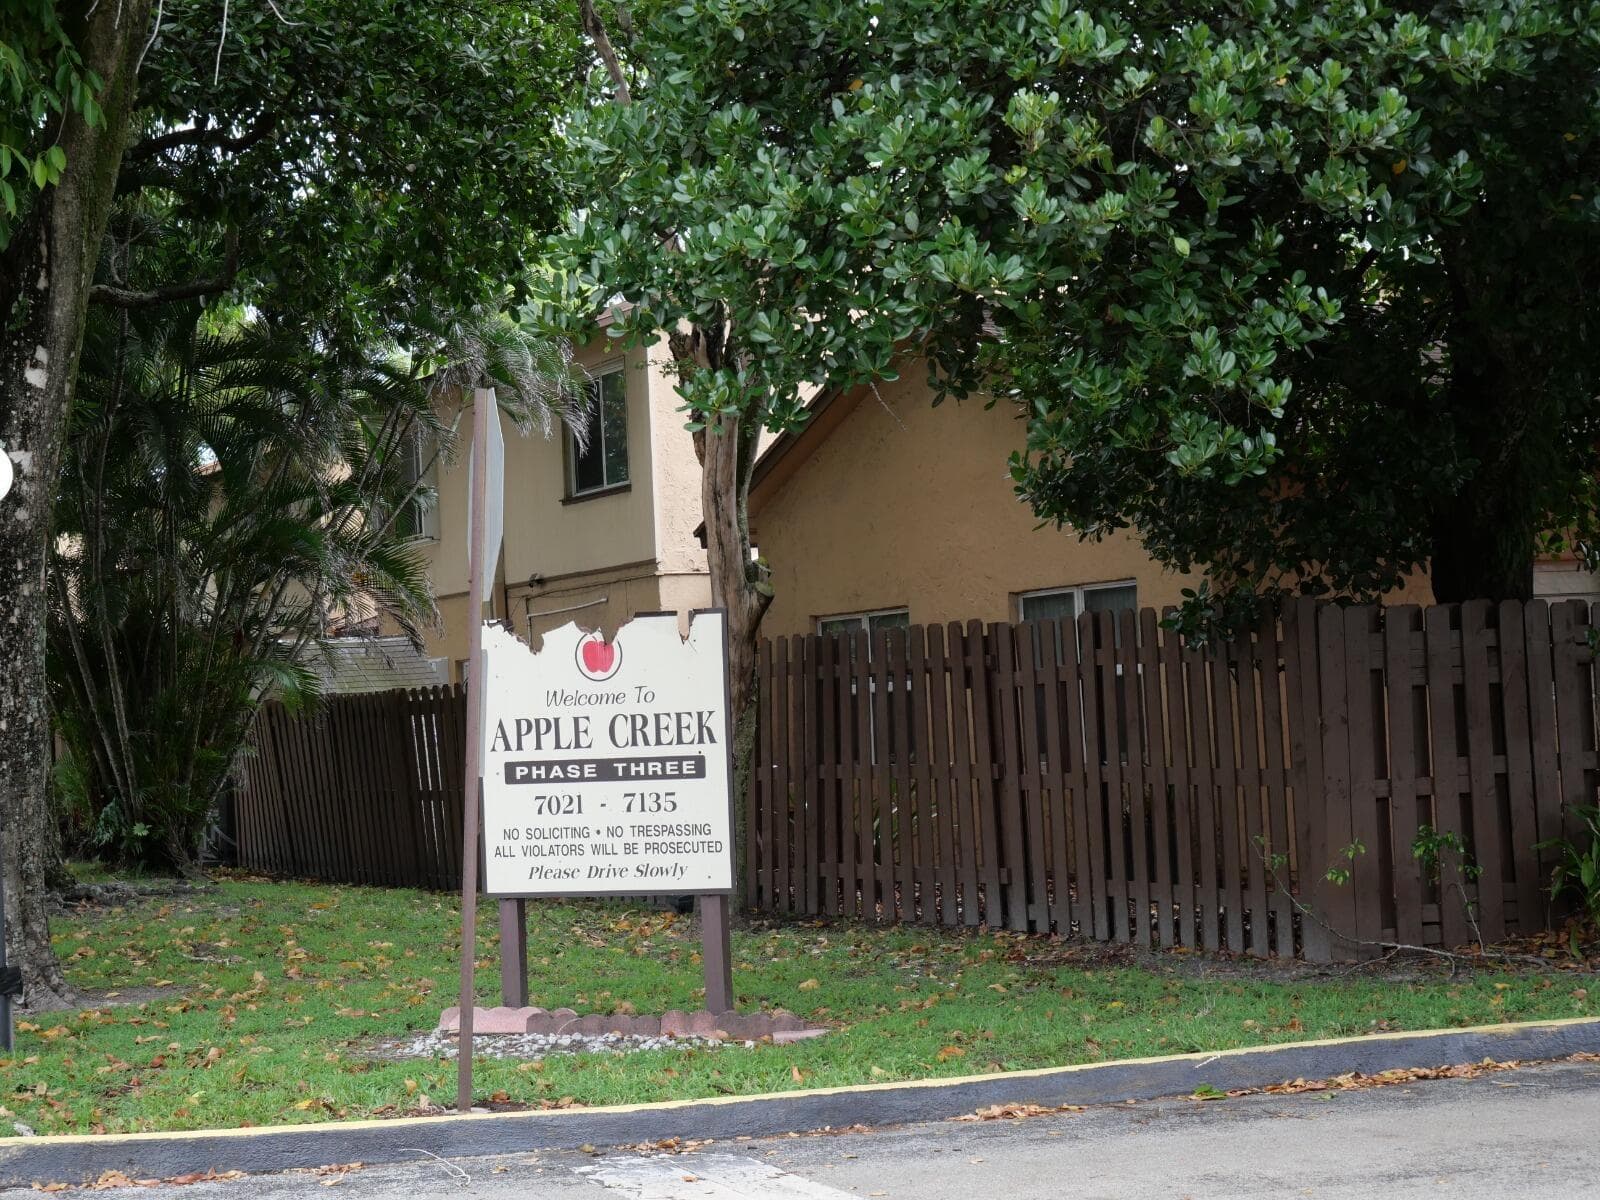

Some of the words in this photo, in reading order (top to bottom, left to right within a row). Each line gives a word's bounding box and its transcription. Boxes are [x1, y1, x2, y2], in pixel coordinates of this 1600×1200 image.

[547, 689, 625, 707] Welcome
[635, 686, 655, 703] To
[491, 716, 592, 752] APPLE
[609, 711, 717, 748] CREEK
[516, 764, 597, 779] PHASE
[614, 761, 695, 776] THREE
[535, 795, 582, 815] 7021
[624, 792, 677, 812] 7135
[504, 829, 519, 840] NO
[526, 827, 589, 840] SOLICITING
[607, 826, 623, 837] NO
[630, 824, 711, 837] TRESPASSING
[495, 846, 515, 857] ALL
[522, 844, 584, 857] VIOLATORS
[591, 844, 618, 855] WILL
[624, 843, 638, 854] BE
[645, 841, 722, 854] PROSECUTED
[529, 866, 580, 879] Please
[588, 864, 628, 878] Drive
[634, 863, 687, 880] Slowly
